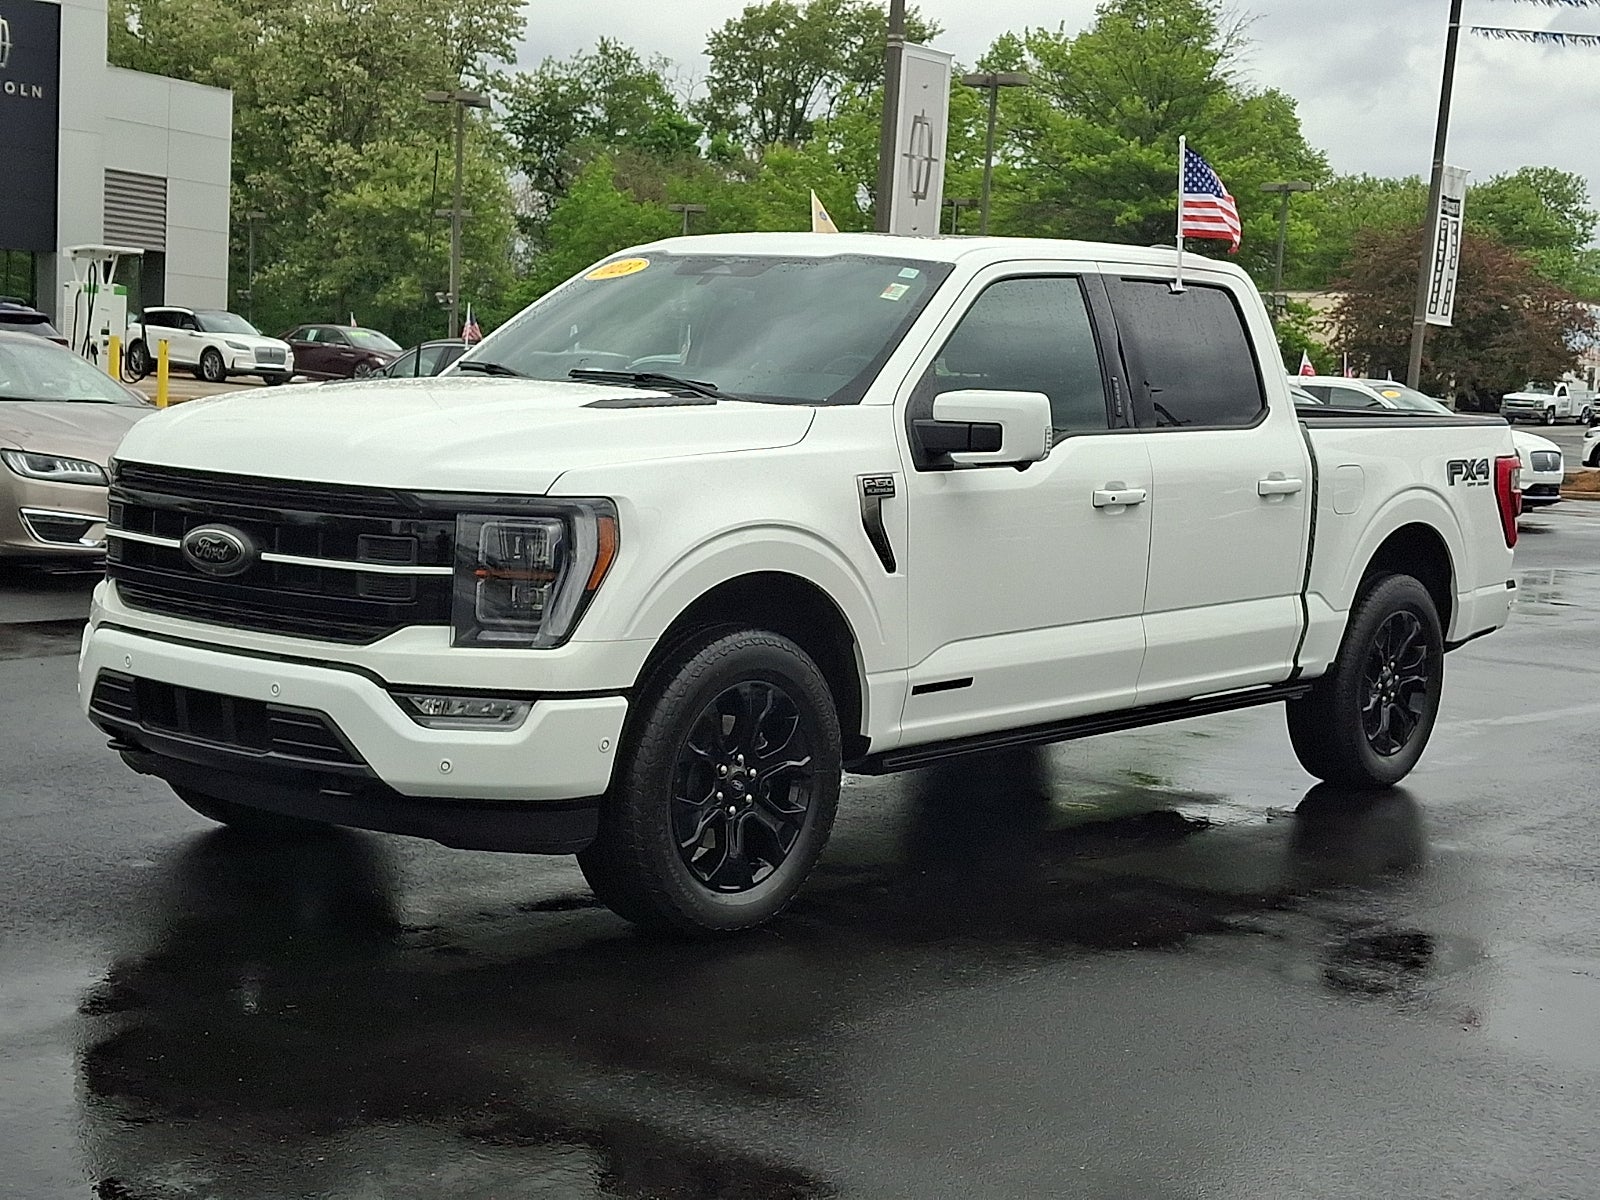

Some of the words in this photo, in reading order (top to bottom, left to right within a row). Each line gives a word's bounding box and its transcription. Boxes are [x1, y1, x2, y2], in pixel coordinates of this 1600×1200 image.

[864, 479, 893, 488] F-150
[1447, 458, 1489, 486] FX4
[195, 536, 230, 560] Ford
